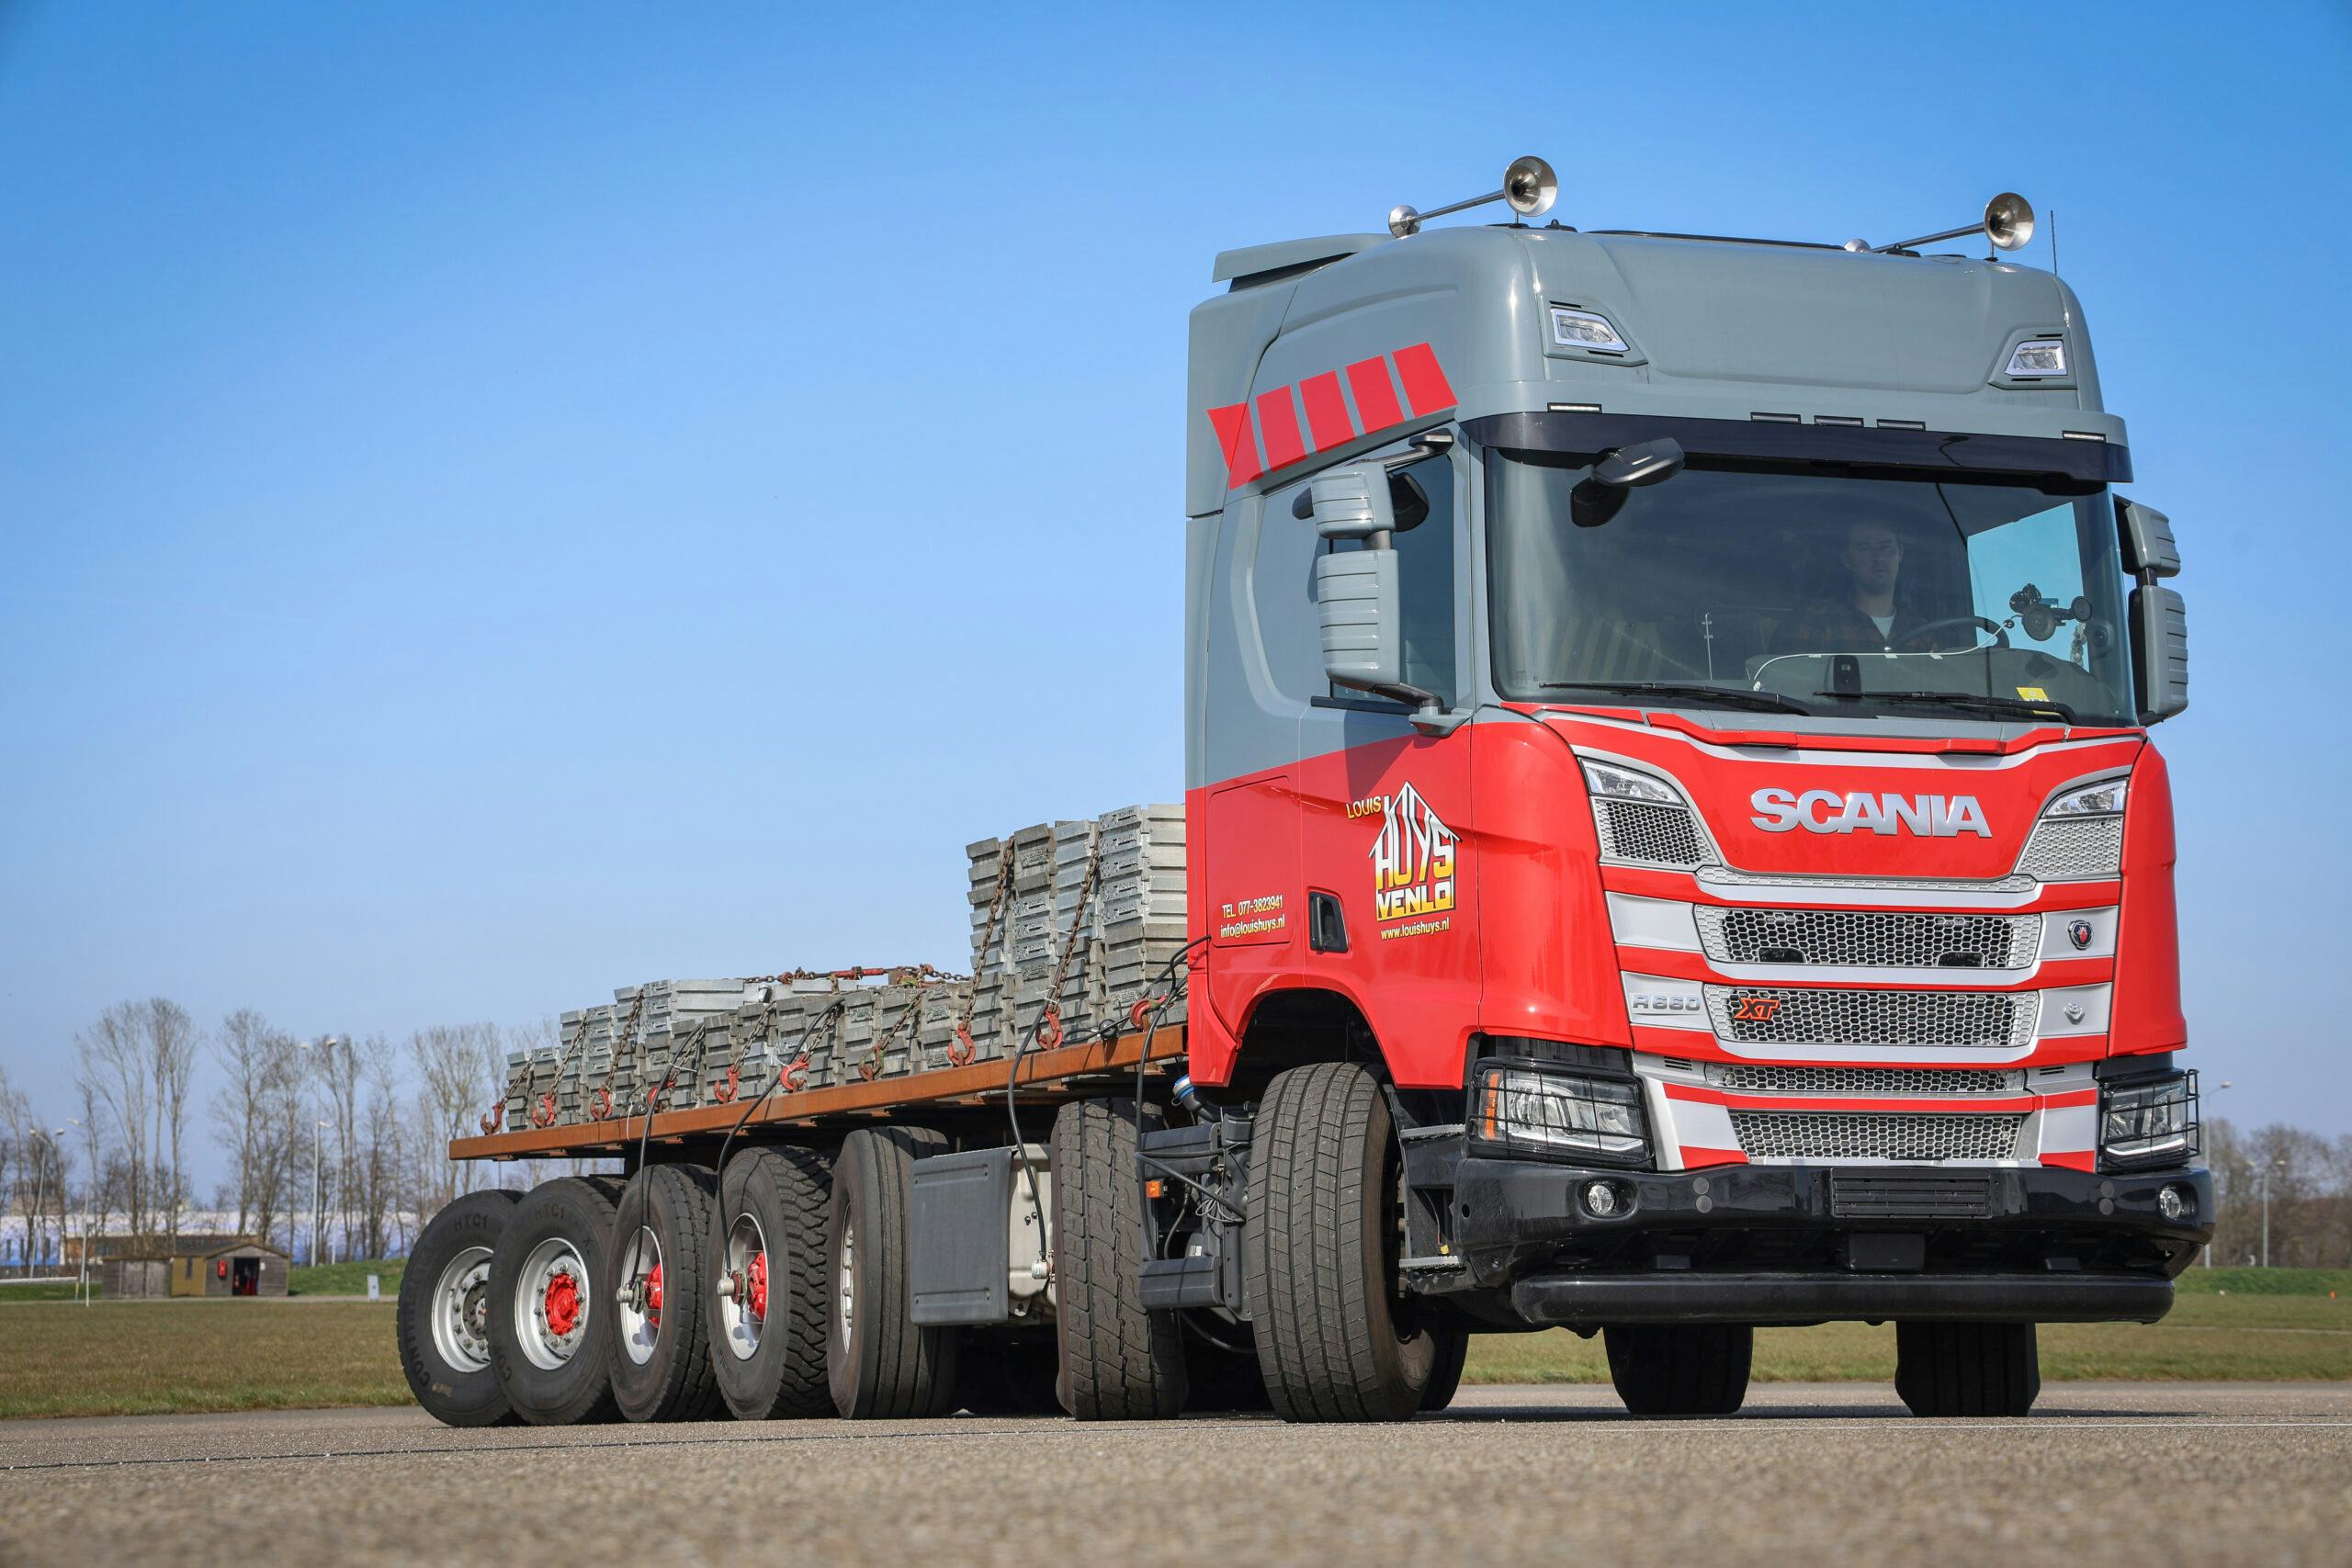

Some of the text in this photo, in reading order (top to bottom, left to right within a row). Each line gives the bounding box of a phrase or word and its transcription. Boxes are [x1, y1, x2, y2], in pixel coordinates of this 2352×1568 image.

[1345, 795, 1382, 820] LOUIS
[1750, 787, 1993, 838] SCANIA
[1373, 781, 1457, 890] HUYS
[1238, 894, 1283, 916] 077-3823941
[1377, 881, 1453, 920] VENLO
[1220, 913, 1285, 938] info@louishuys.nl
[1381, 917, 1451, 941] www.louishuys.nl
[1734, 997, 1781, 1021] XT
